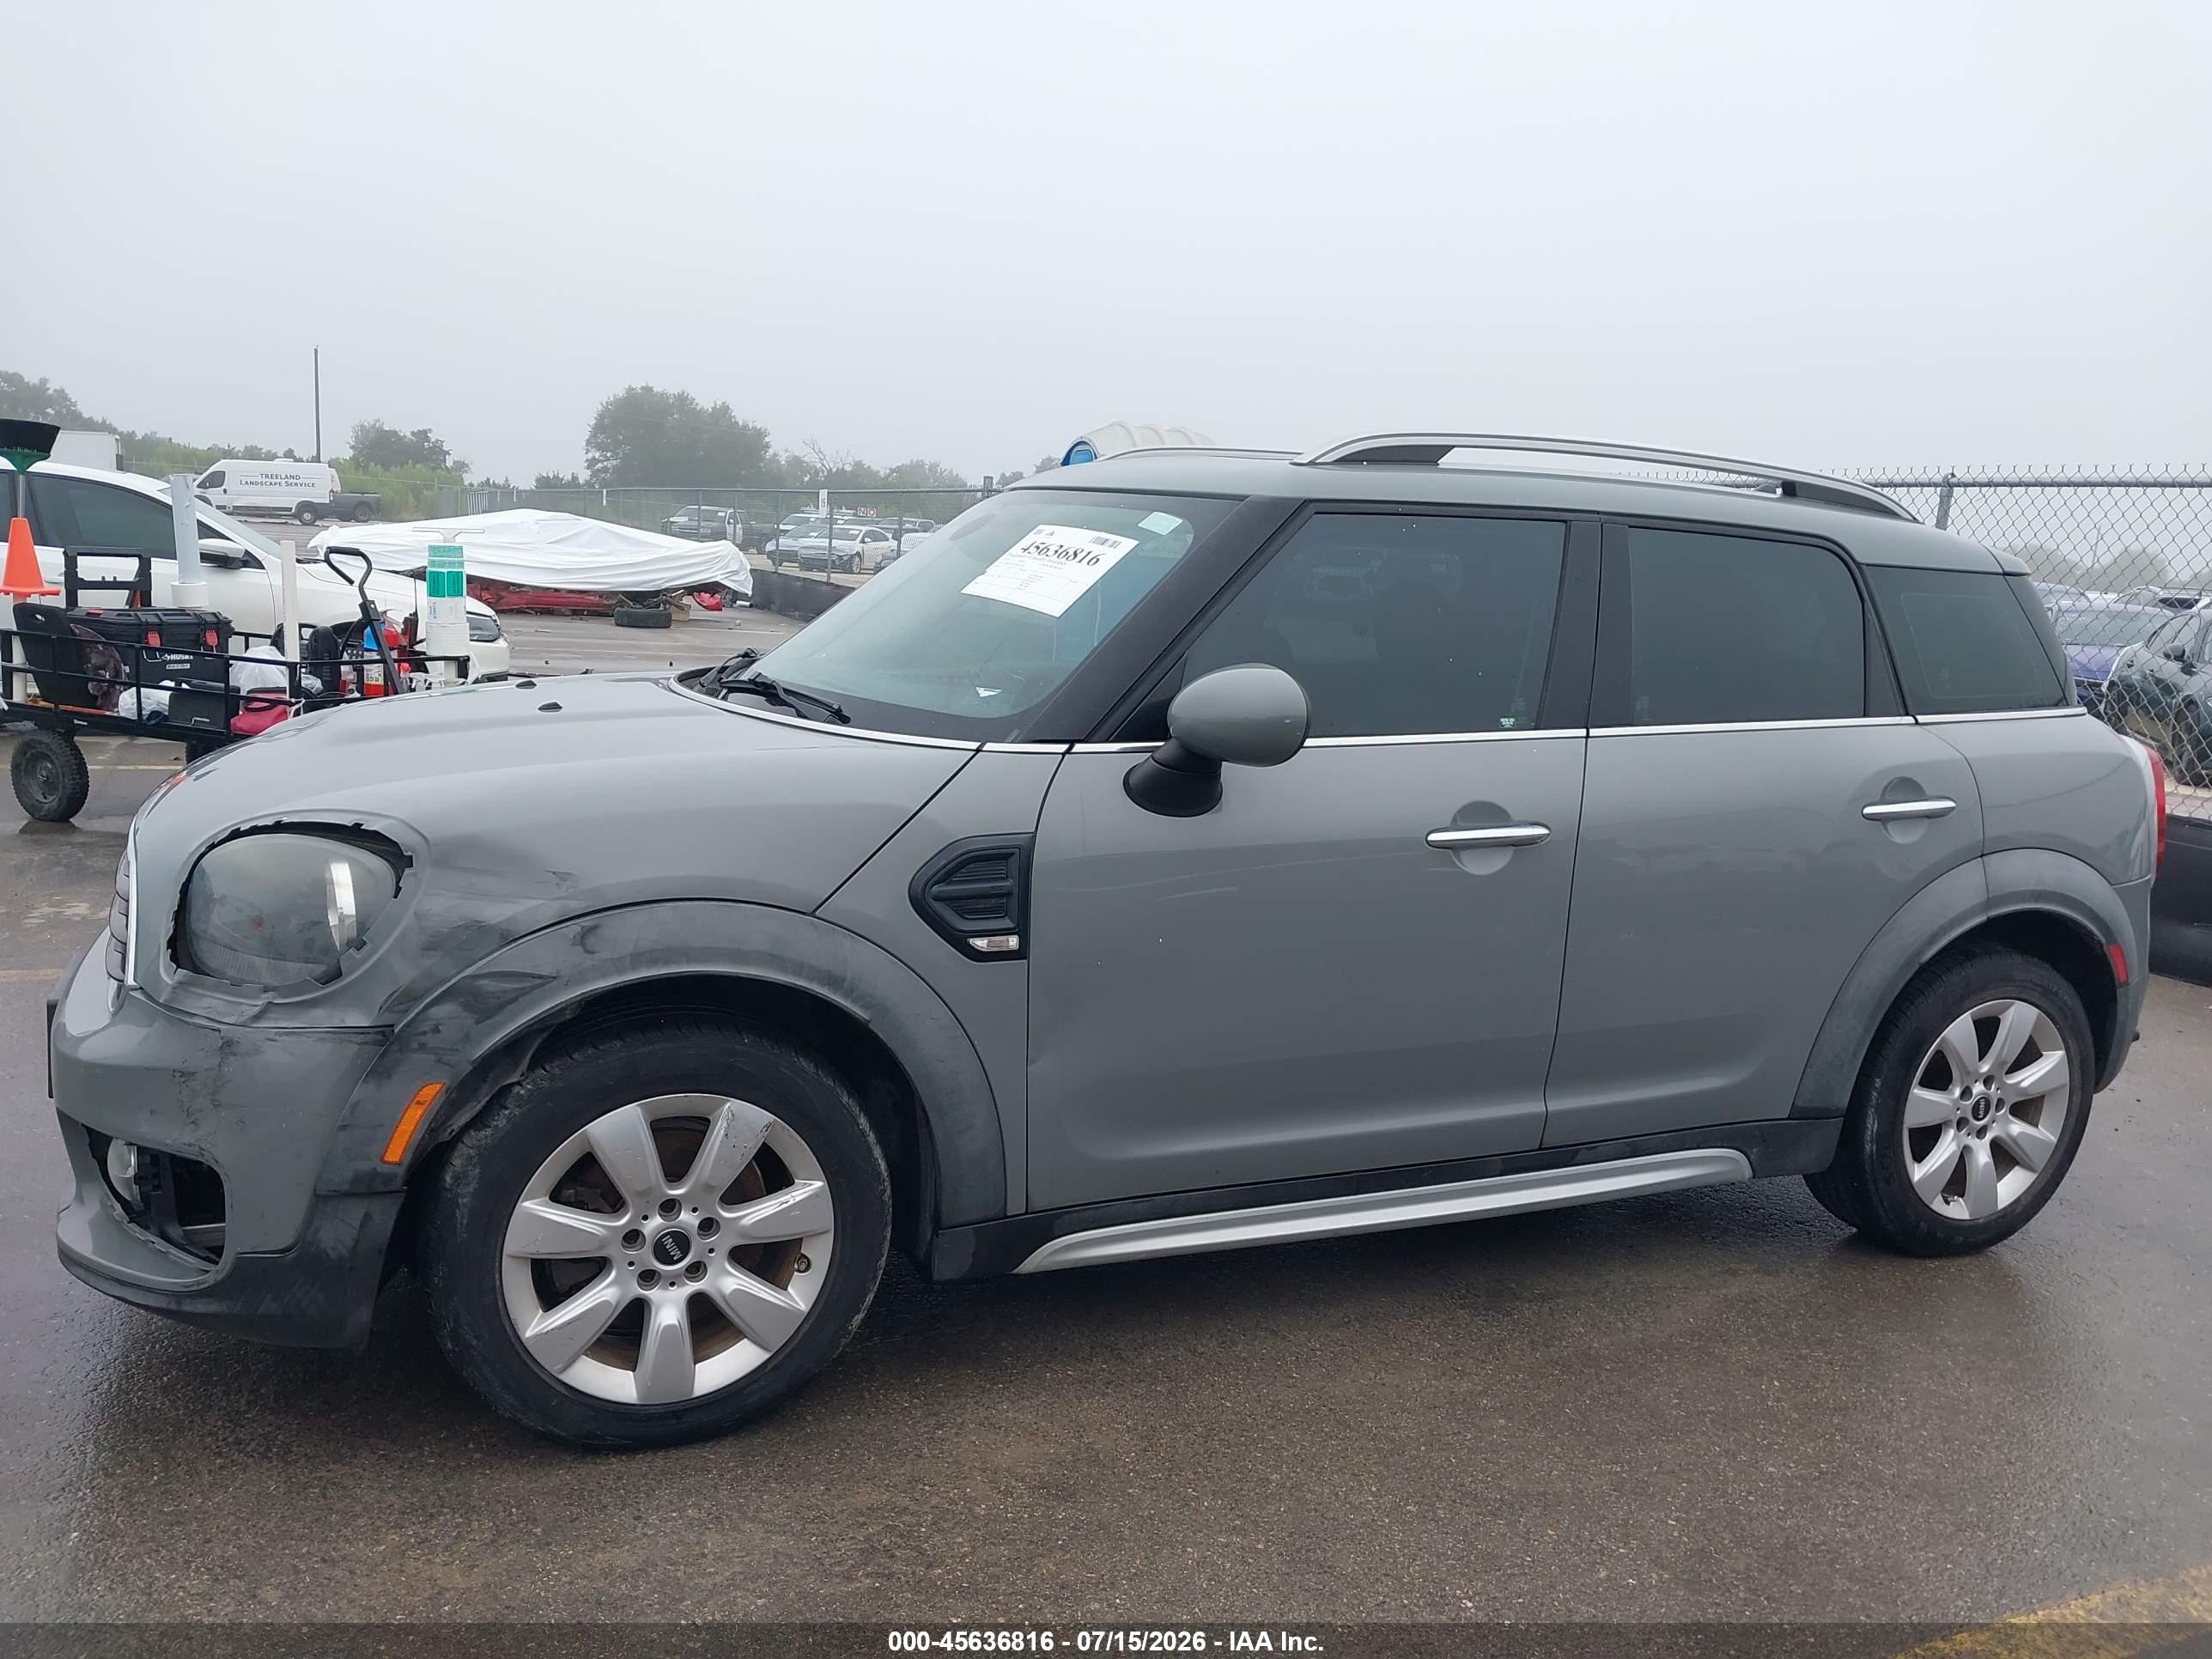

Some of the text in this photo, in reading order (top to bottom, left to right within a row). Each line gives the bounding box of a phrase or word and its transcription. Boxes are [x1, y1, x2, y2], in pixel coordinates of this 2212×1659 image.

[1020, 541, 1106, 566] 45636816
[1978, 1099, 1986, 1119] MINI
[661, 1235, 684, 1261] MINI
